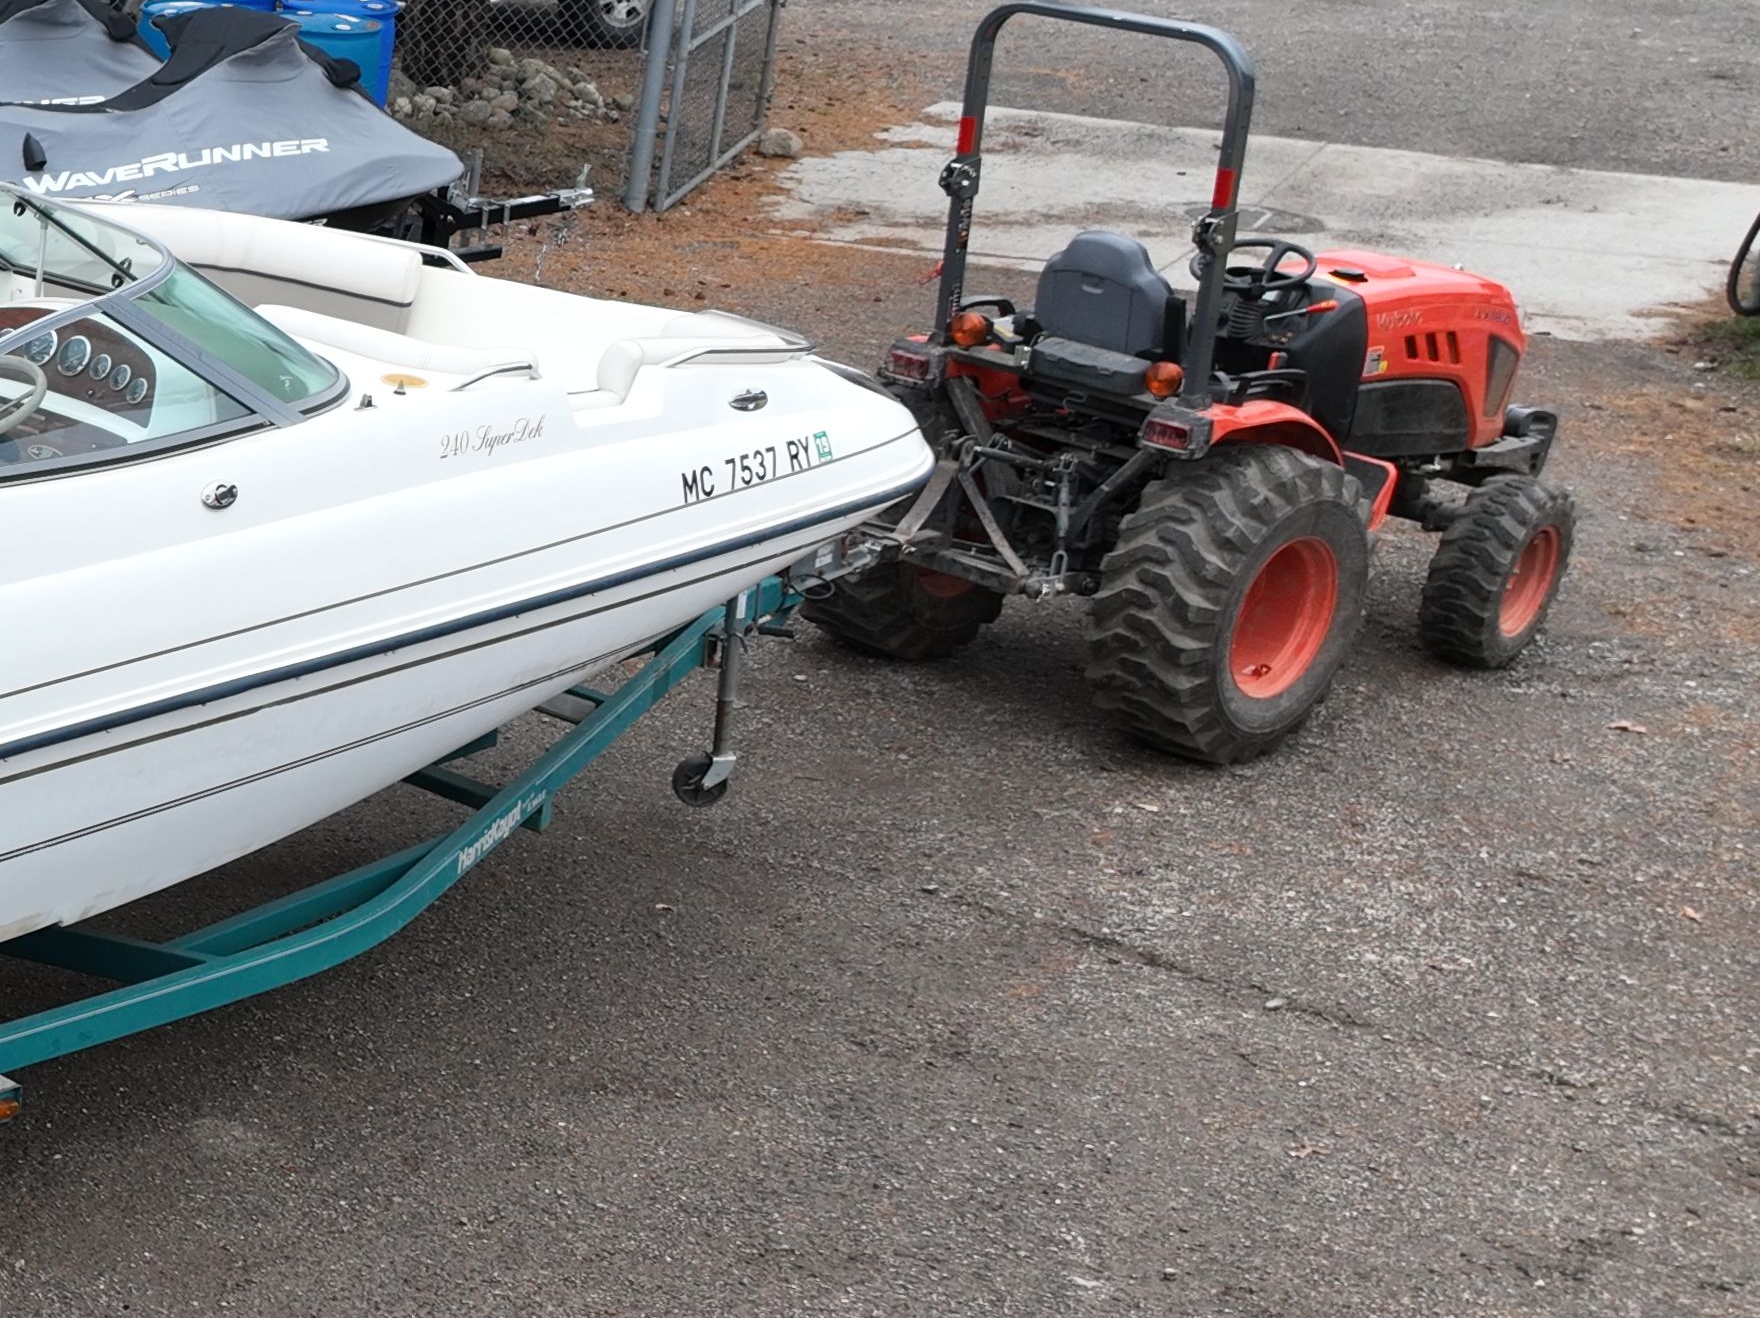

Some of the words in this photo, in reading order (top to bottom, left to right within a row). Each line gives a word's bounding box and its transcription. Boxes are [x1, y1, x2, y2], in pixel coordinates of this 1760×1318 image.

[440, 429, 469, 459] 240
[681, 465, 715, 504] MC
[724, 446, 777, 491] 7537
[786, 436, 811, 472] RY
[457, 799, 522, 874] HarrisKayot
